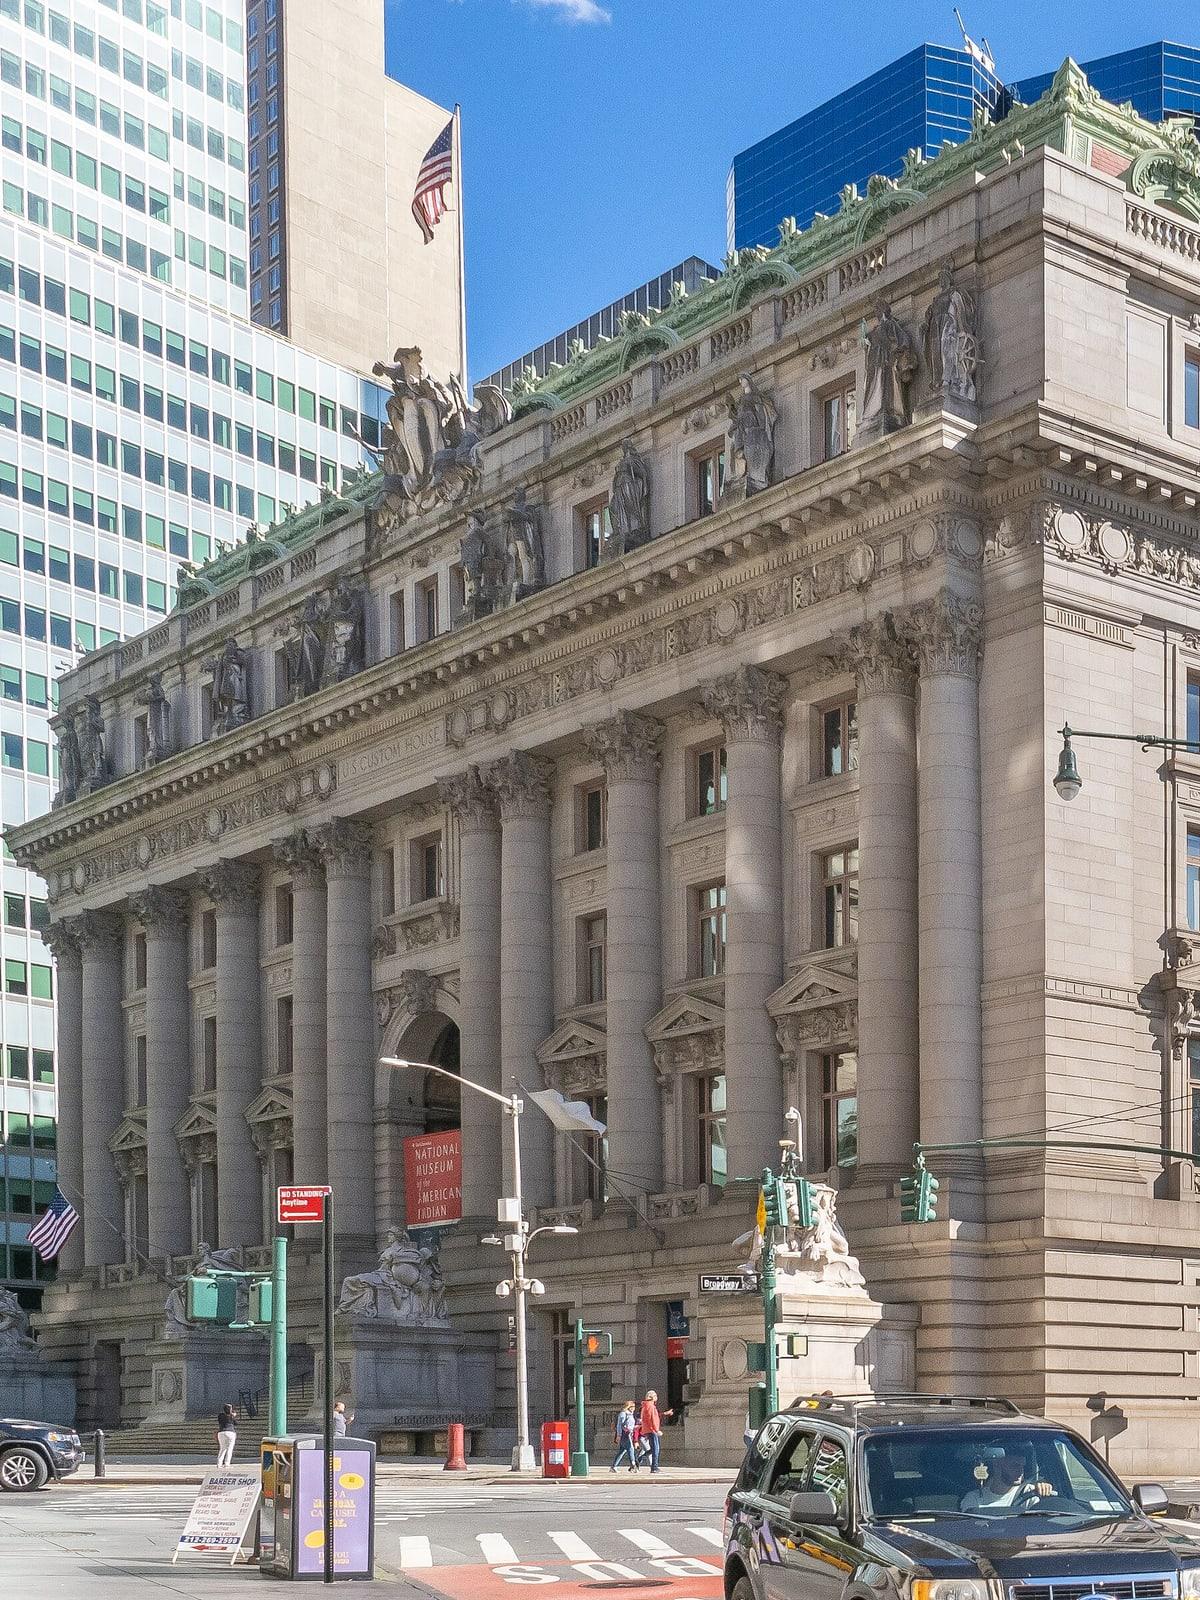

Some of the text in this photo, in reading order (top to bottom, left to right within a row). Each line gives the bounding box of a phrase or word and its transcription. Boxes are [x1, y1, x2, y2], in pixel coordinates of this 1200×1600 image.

[359, 742, 402, 772] CUSTOM
[404, 726, 441, 752] HOUSE
[415, 1142, 460, 1161] NATIONAL
[416, 1159, 454, 1177] MUSEUM
[281, 1190, 324, 1198] NO STANDING
[417, 1186, 462, 1205] AMERICAN
[281, 1199, 308, 1207] Anytime
[417, 1204, 448, 1220] INDIAN
[704, 1280, 740, 1290] Broadway
[209, 1477, 257, 1486] BARBER SHOP
[491, 1556, 725, 1585] BUS
